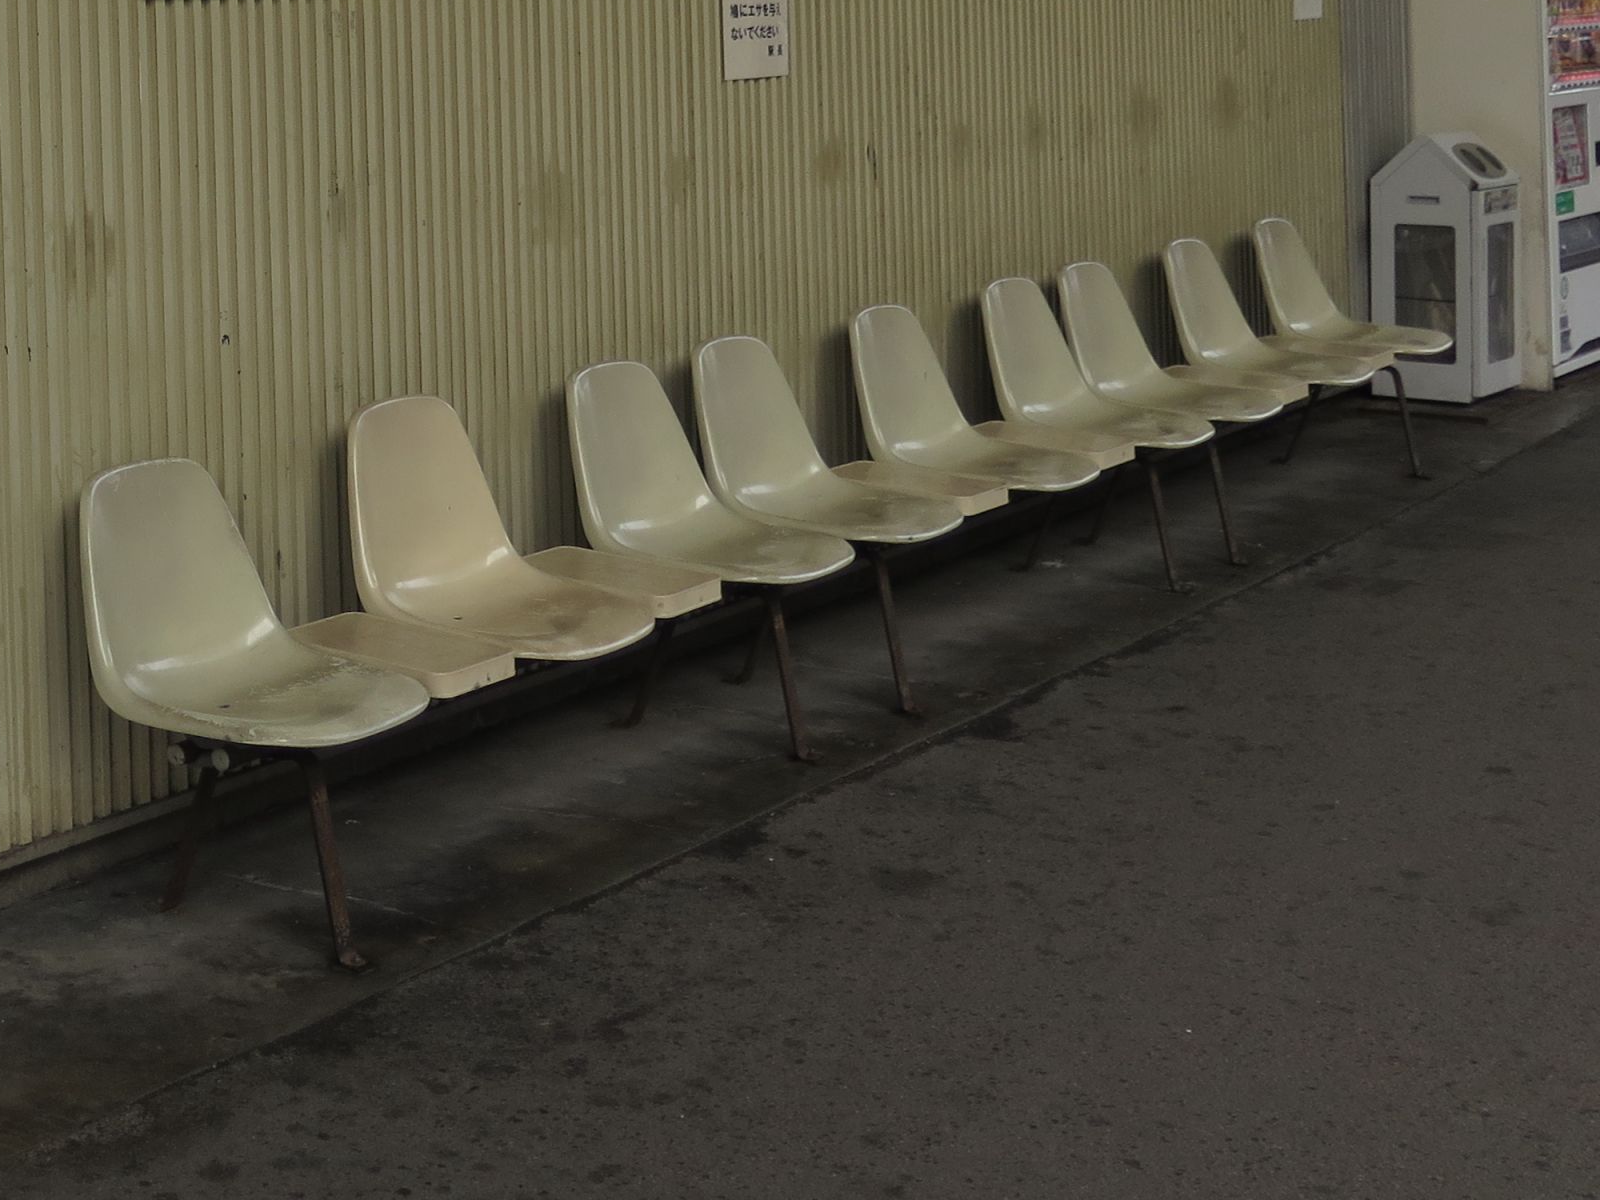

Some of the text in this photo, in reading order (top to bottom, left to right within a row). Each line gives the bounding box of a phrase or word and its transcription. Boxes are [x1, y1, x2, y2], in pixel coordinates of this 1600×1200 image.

[730, 25, 780, 41] ないでください
